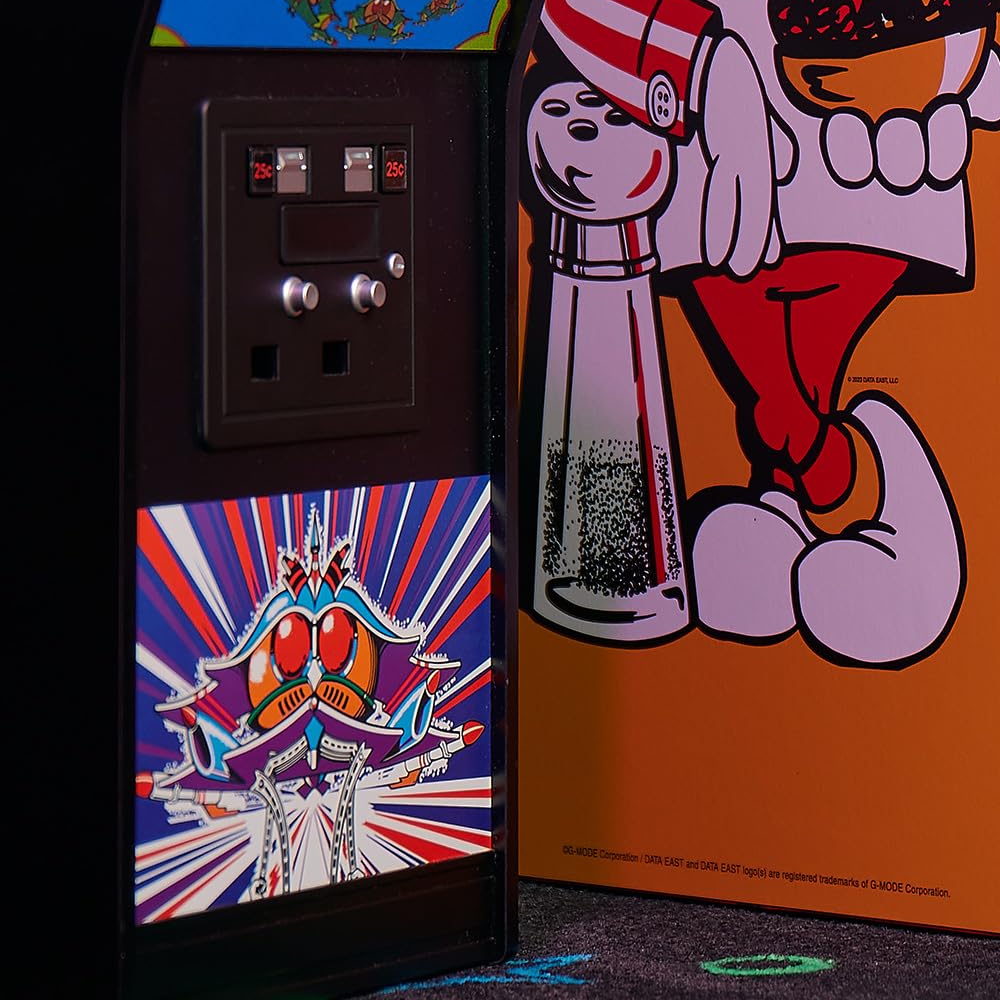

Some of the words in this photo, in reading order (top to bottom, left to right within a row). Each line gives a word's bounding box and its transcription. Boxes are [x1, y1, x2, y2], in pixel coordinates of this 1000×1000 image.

[644, 854, 662, 865] DATA
[664, 856, 685, 868] EAST
[686, 859, 699, 870] and
[700, 860, 719, 872] DATA
[720, 862, 741, 875] EAST
[768, 869, 780, 879] are
[782, 870, 818, 883] registered
[819, 874, 859, 888] trademarks
[861, 879, 869, 889] of
